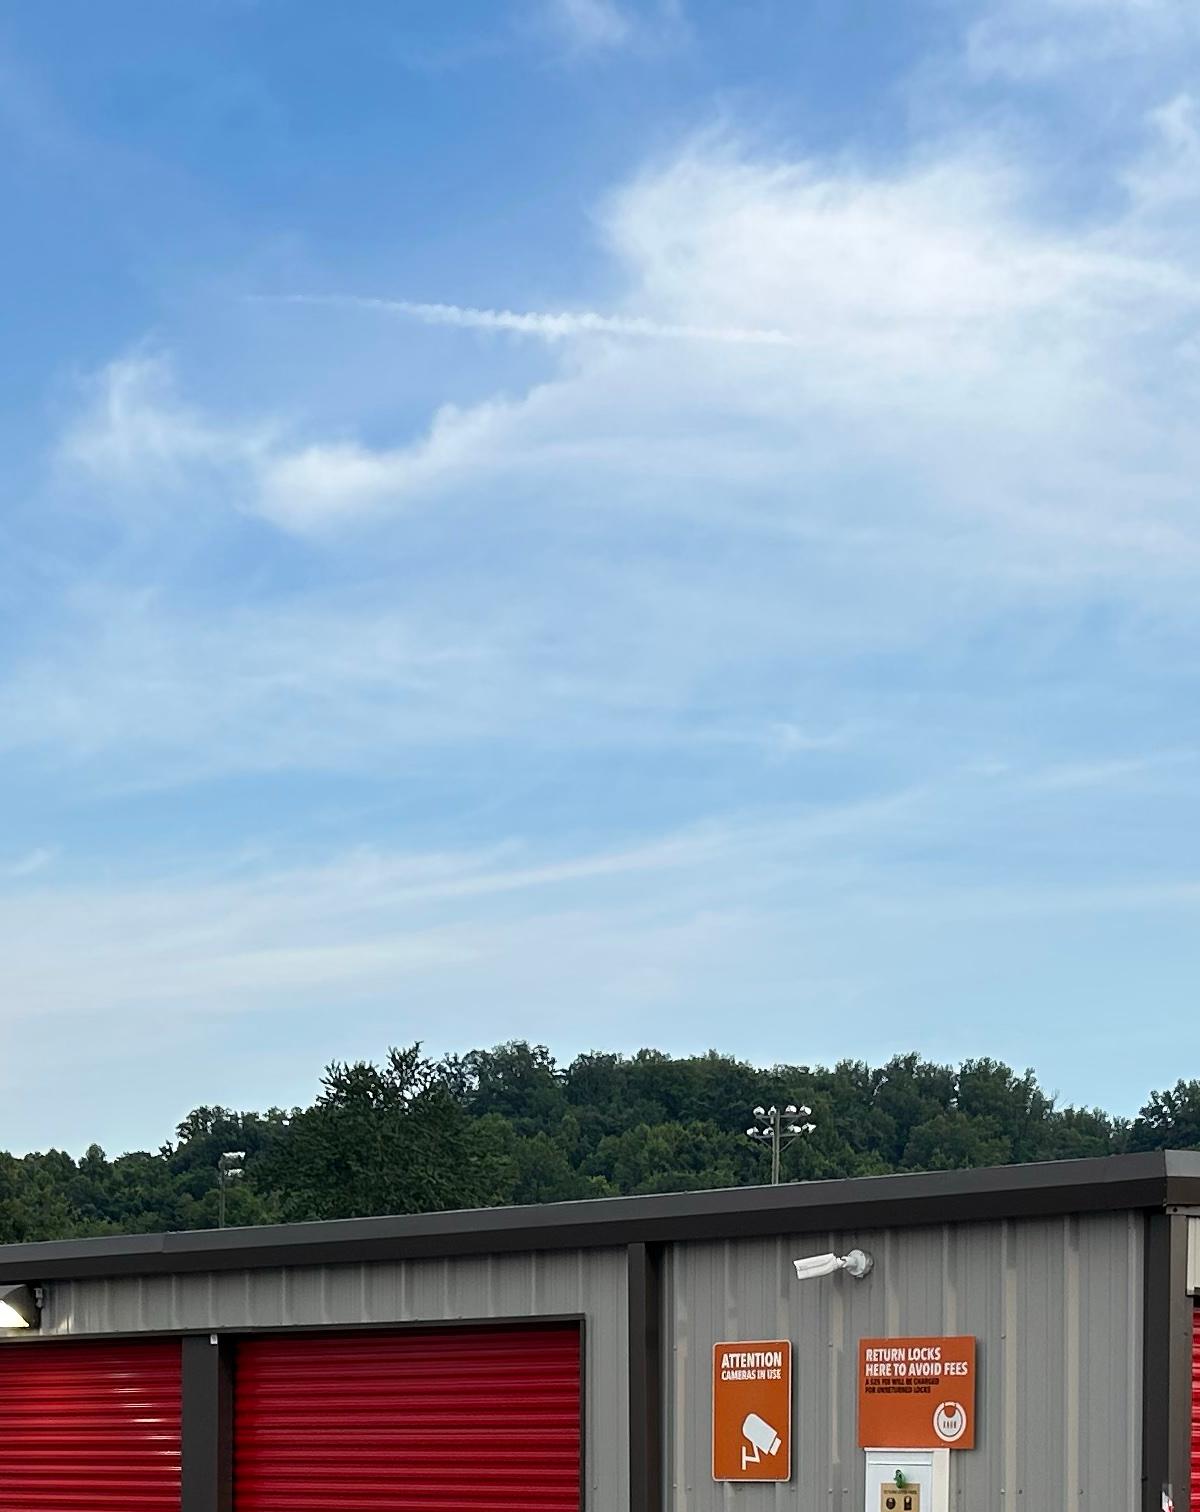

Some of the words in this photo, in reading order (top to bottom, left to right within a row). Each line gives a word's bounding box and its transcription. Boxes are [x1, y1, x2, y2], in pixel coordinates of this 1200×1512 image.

[721, 1352, 782, 1368] ATTENTION
[865, 1348, 906, 1362] RETURN
[907, 1347, 941, 1361] LOCKS
[721, 1370, 757, 1380] CAMERAS
[757, 1369, 766, 1380] IN
[766, 1369, 781, 1379] USE
[865, 1363, 892, 1377] HERE
[893, 1362, 907, 1376] TO
[908, 1362, 942, 1376] AVOID
[943, 1361, 968, 1376] FEES
